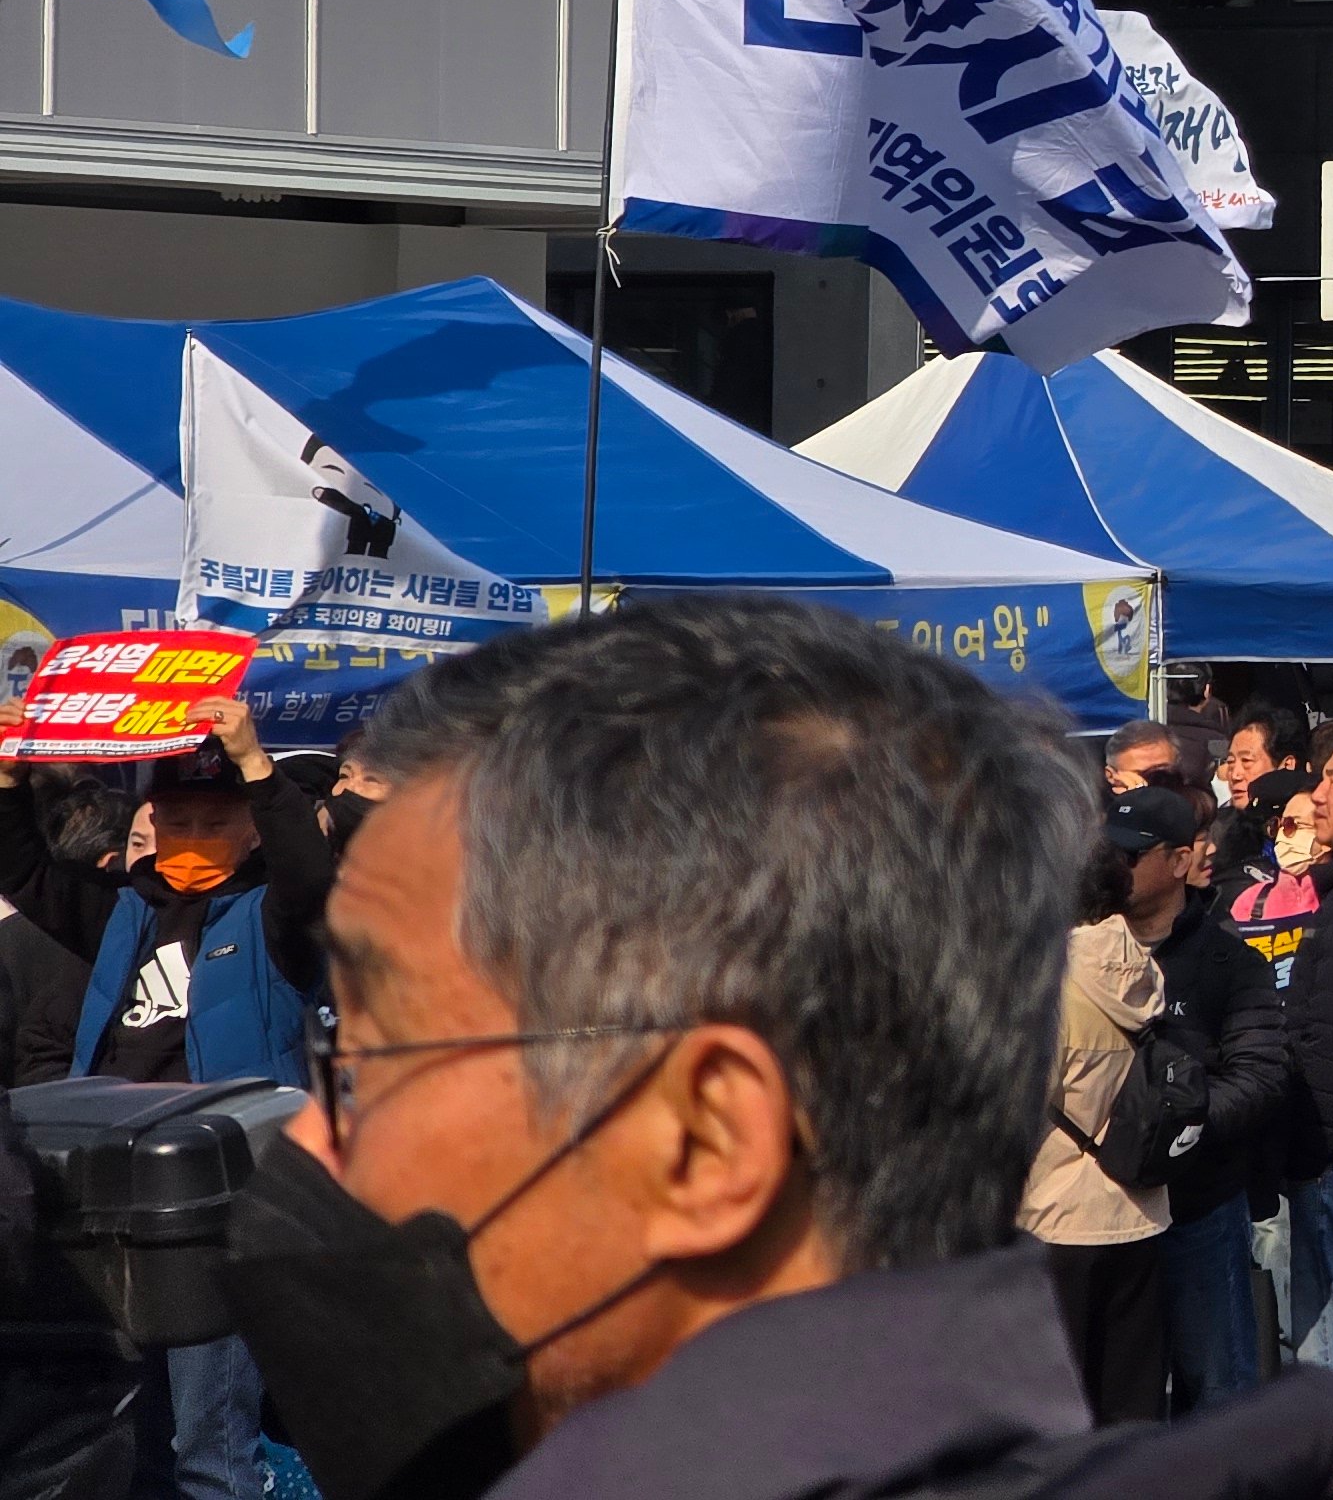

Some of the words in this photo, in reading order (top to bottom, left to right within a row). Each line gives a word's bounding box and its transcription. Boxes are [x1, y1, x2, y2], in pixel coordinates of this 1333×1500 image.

[200, 558, 294, 599] 주블리를
[303, 566, 395, 599] 좋아하는
[401, 573, 481, 608] 사람들
[487, 582, 534, 613] 연합
[315, 606, 385, 632] 국회의원
[386, 613, 453, 637] 화이팅!!
[39, 643, 160, 677] 윤석열
[131, 649, 245, 685] 파면!
[23, 692, 138, 724] 국힘당
[278, 690, 332, 722] 함께
